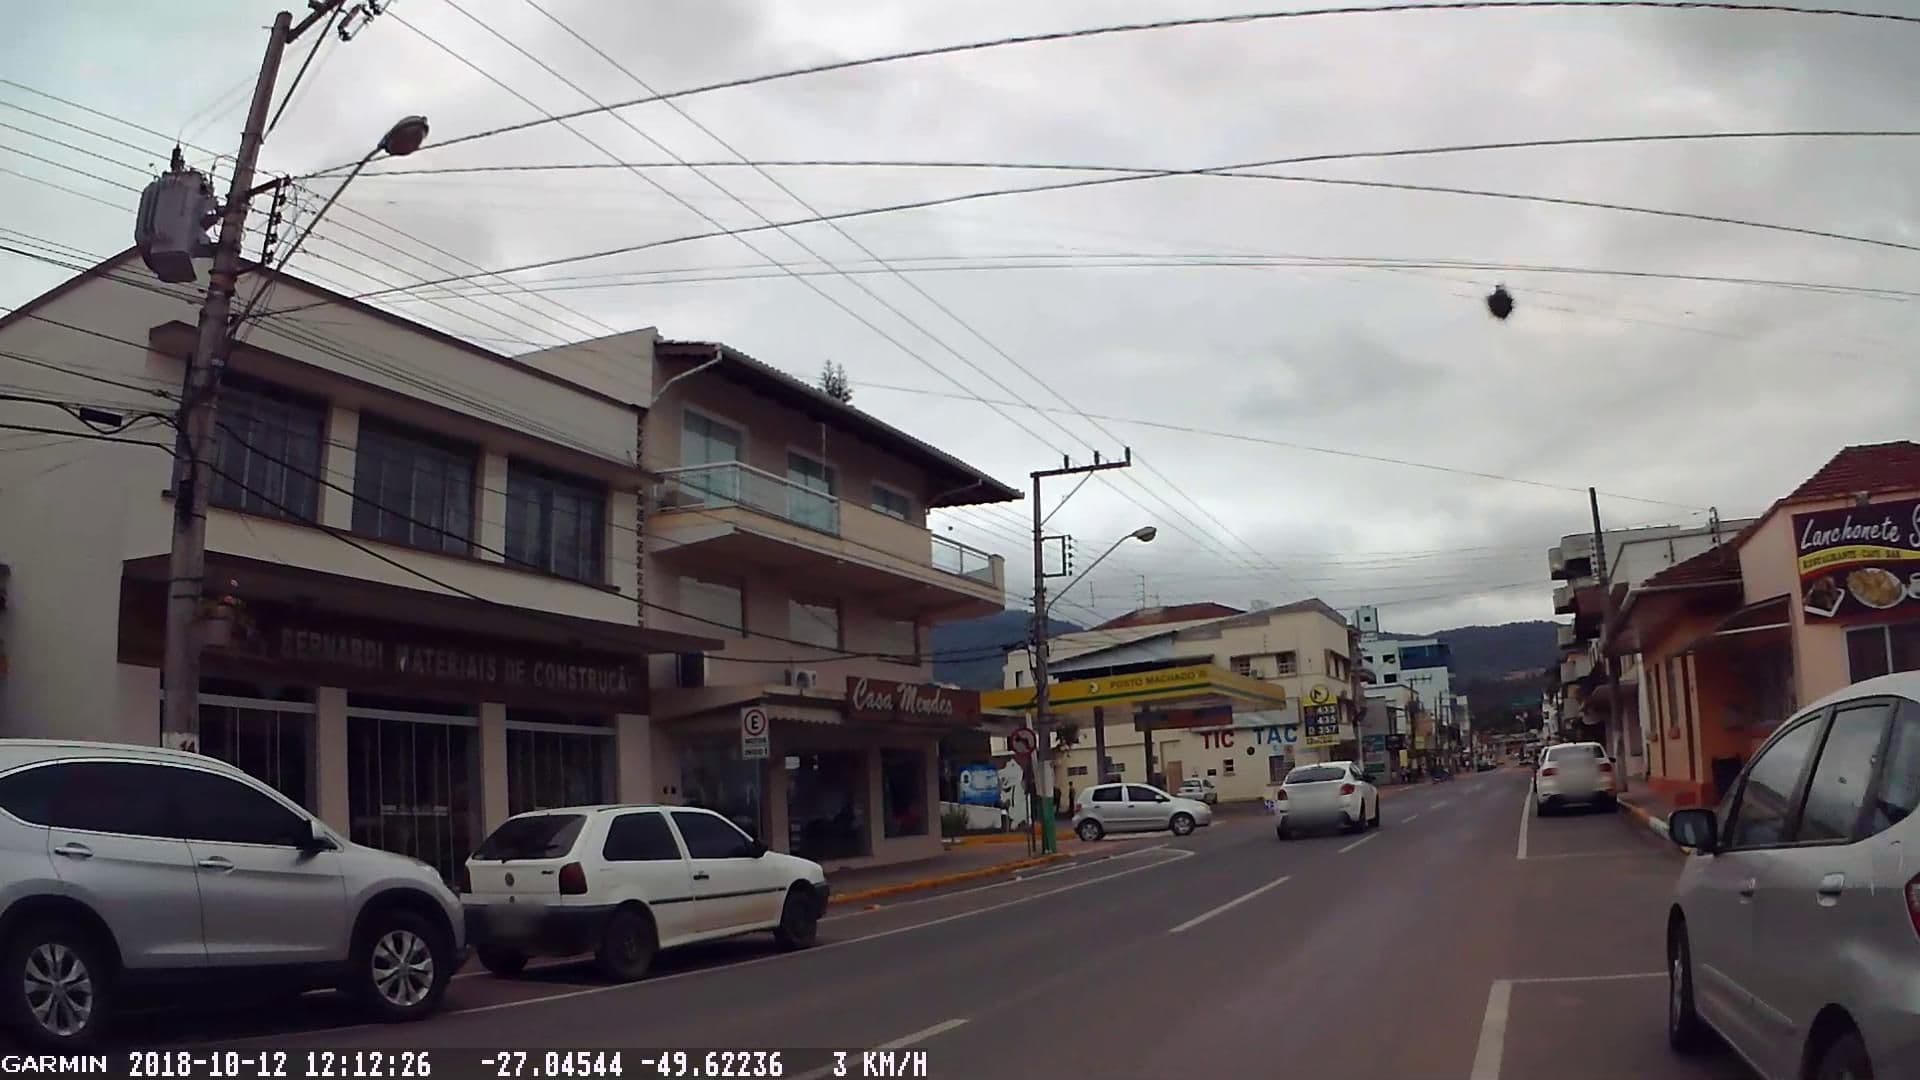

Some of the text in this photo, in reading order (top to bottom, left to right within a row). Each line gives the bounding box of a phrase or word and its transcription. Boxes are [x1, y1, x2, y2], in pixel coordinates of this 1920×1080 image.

[1801, 515, 1900, 550] Lanchonete
[280, 628, 384, 671] BERNARDI
[397, 643, 497, 682] MATERIAIS
[505, 658, 526, 682] DE
[853, 677, 953, 715] Casa Mendes
[1110, 679, 1144, 689] POSTO
[751, 715, 759, 730] E
[1201, 730, 1235, 750] TIC
[1253, 725, 1298, 745] TAC
